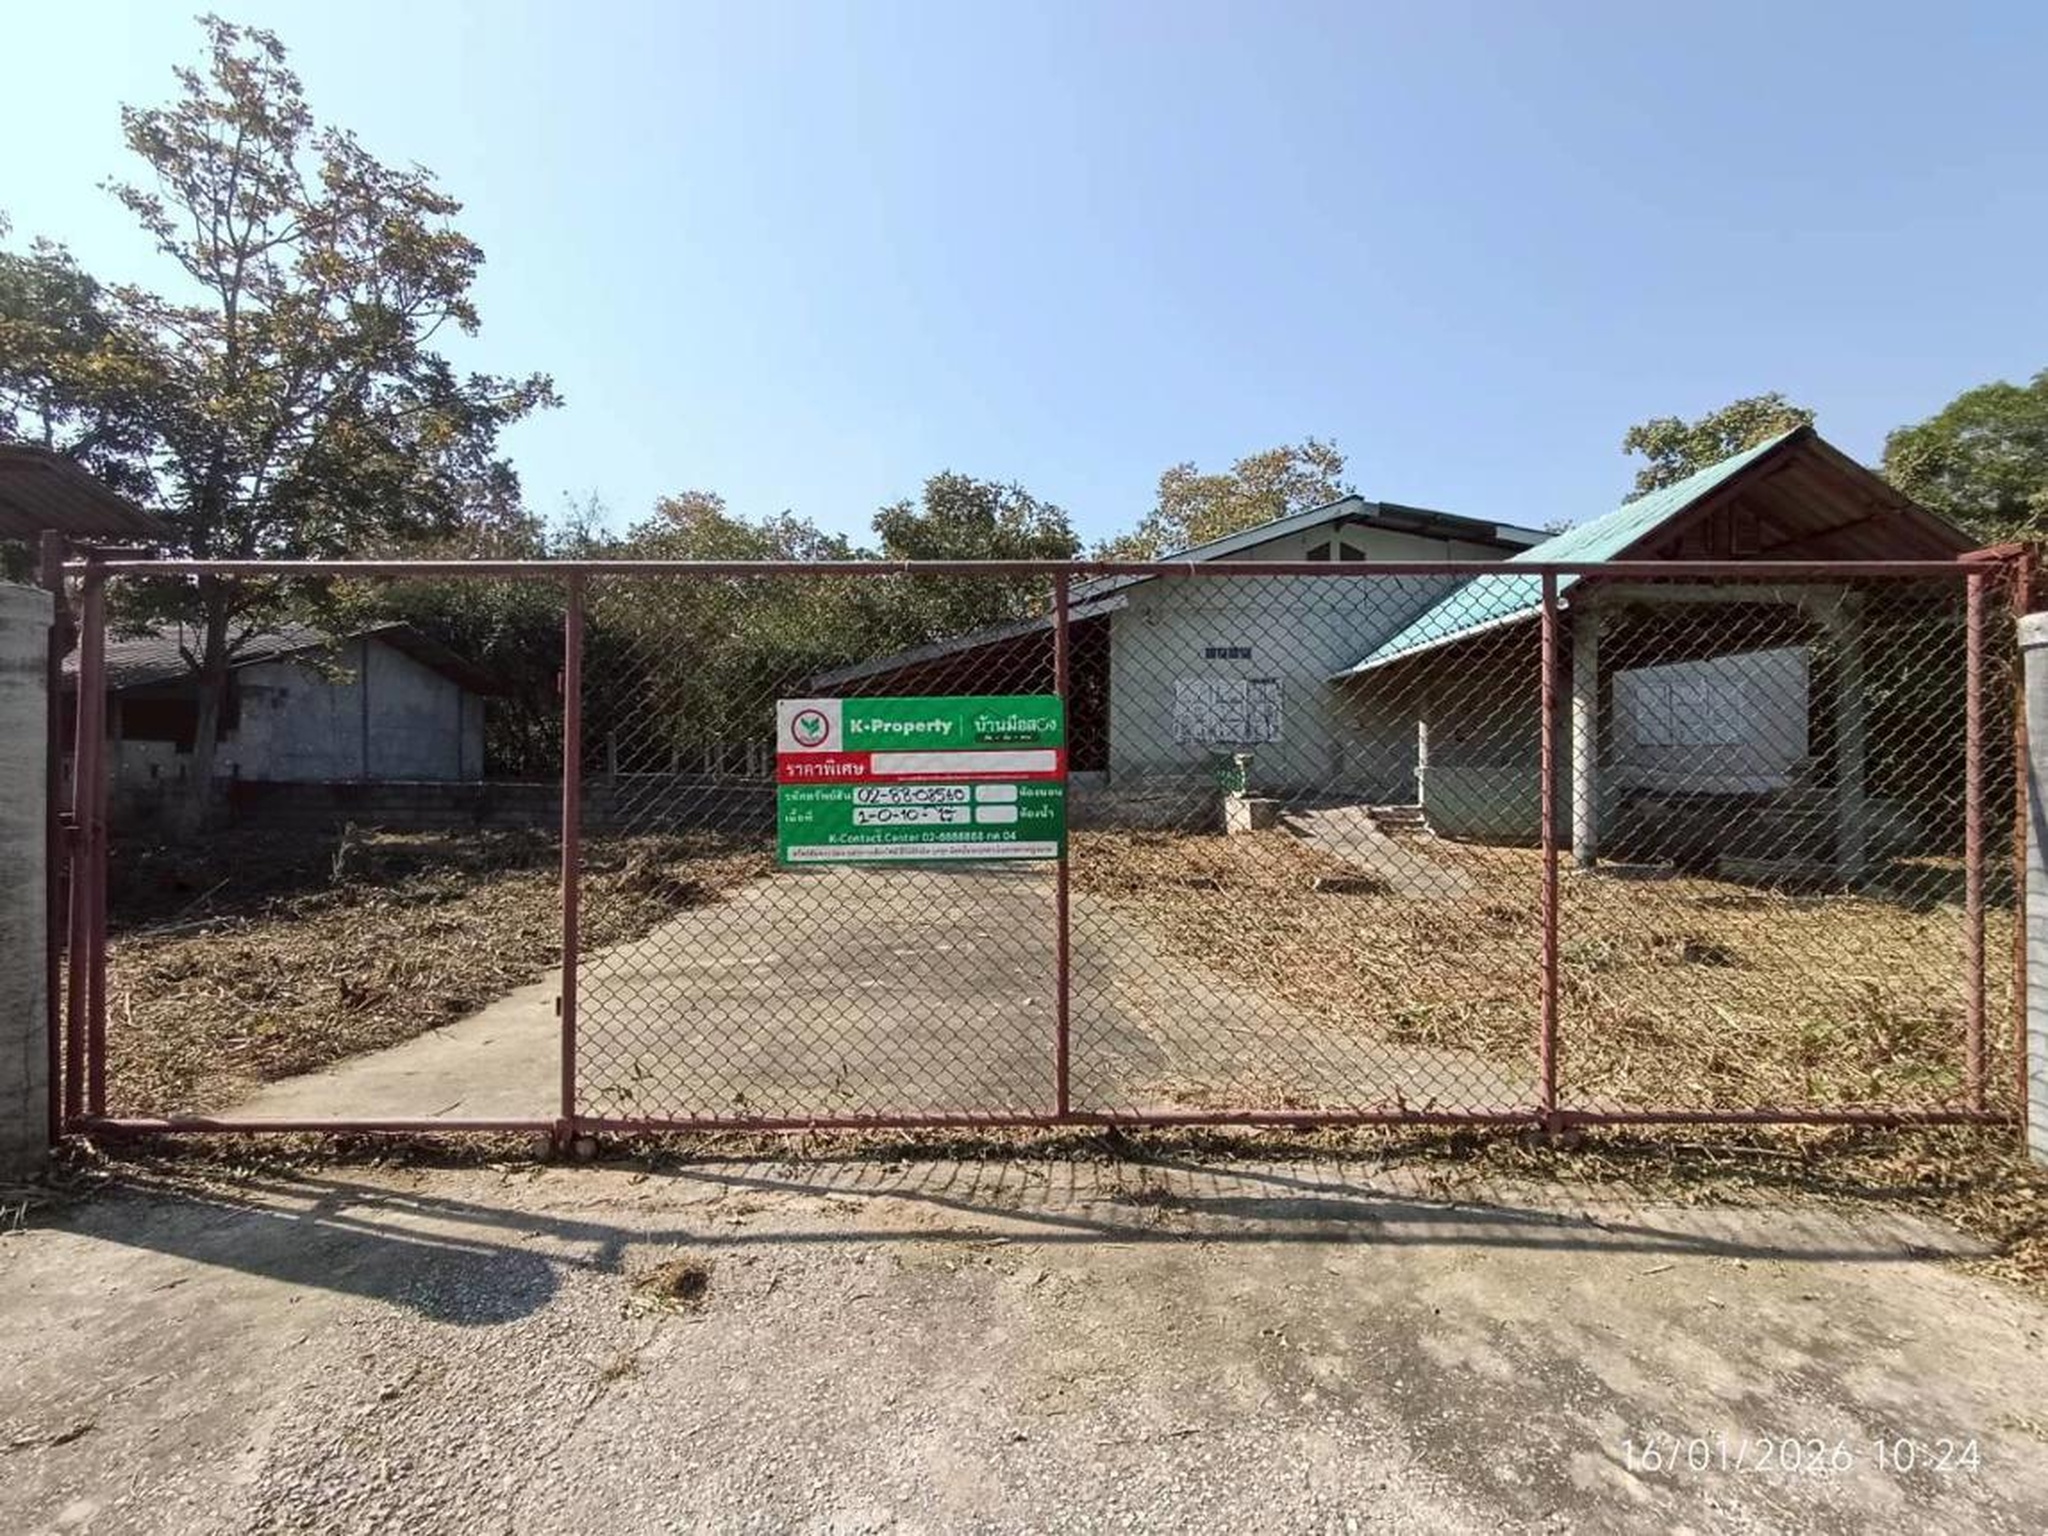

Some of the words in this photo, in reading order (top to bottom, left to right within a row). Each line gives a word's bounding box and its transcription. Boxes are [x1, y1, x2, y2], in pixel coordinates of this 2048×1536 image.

[850, 717, 953, 736] K-Property
[974, 713, 1058, 733] บ้านมือสอง
[785, 758, 865, 777] ราคาพิเศษ
